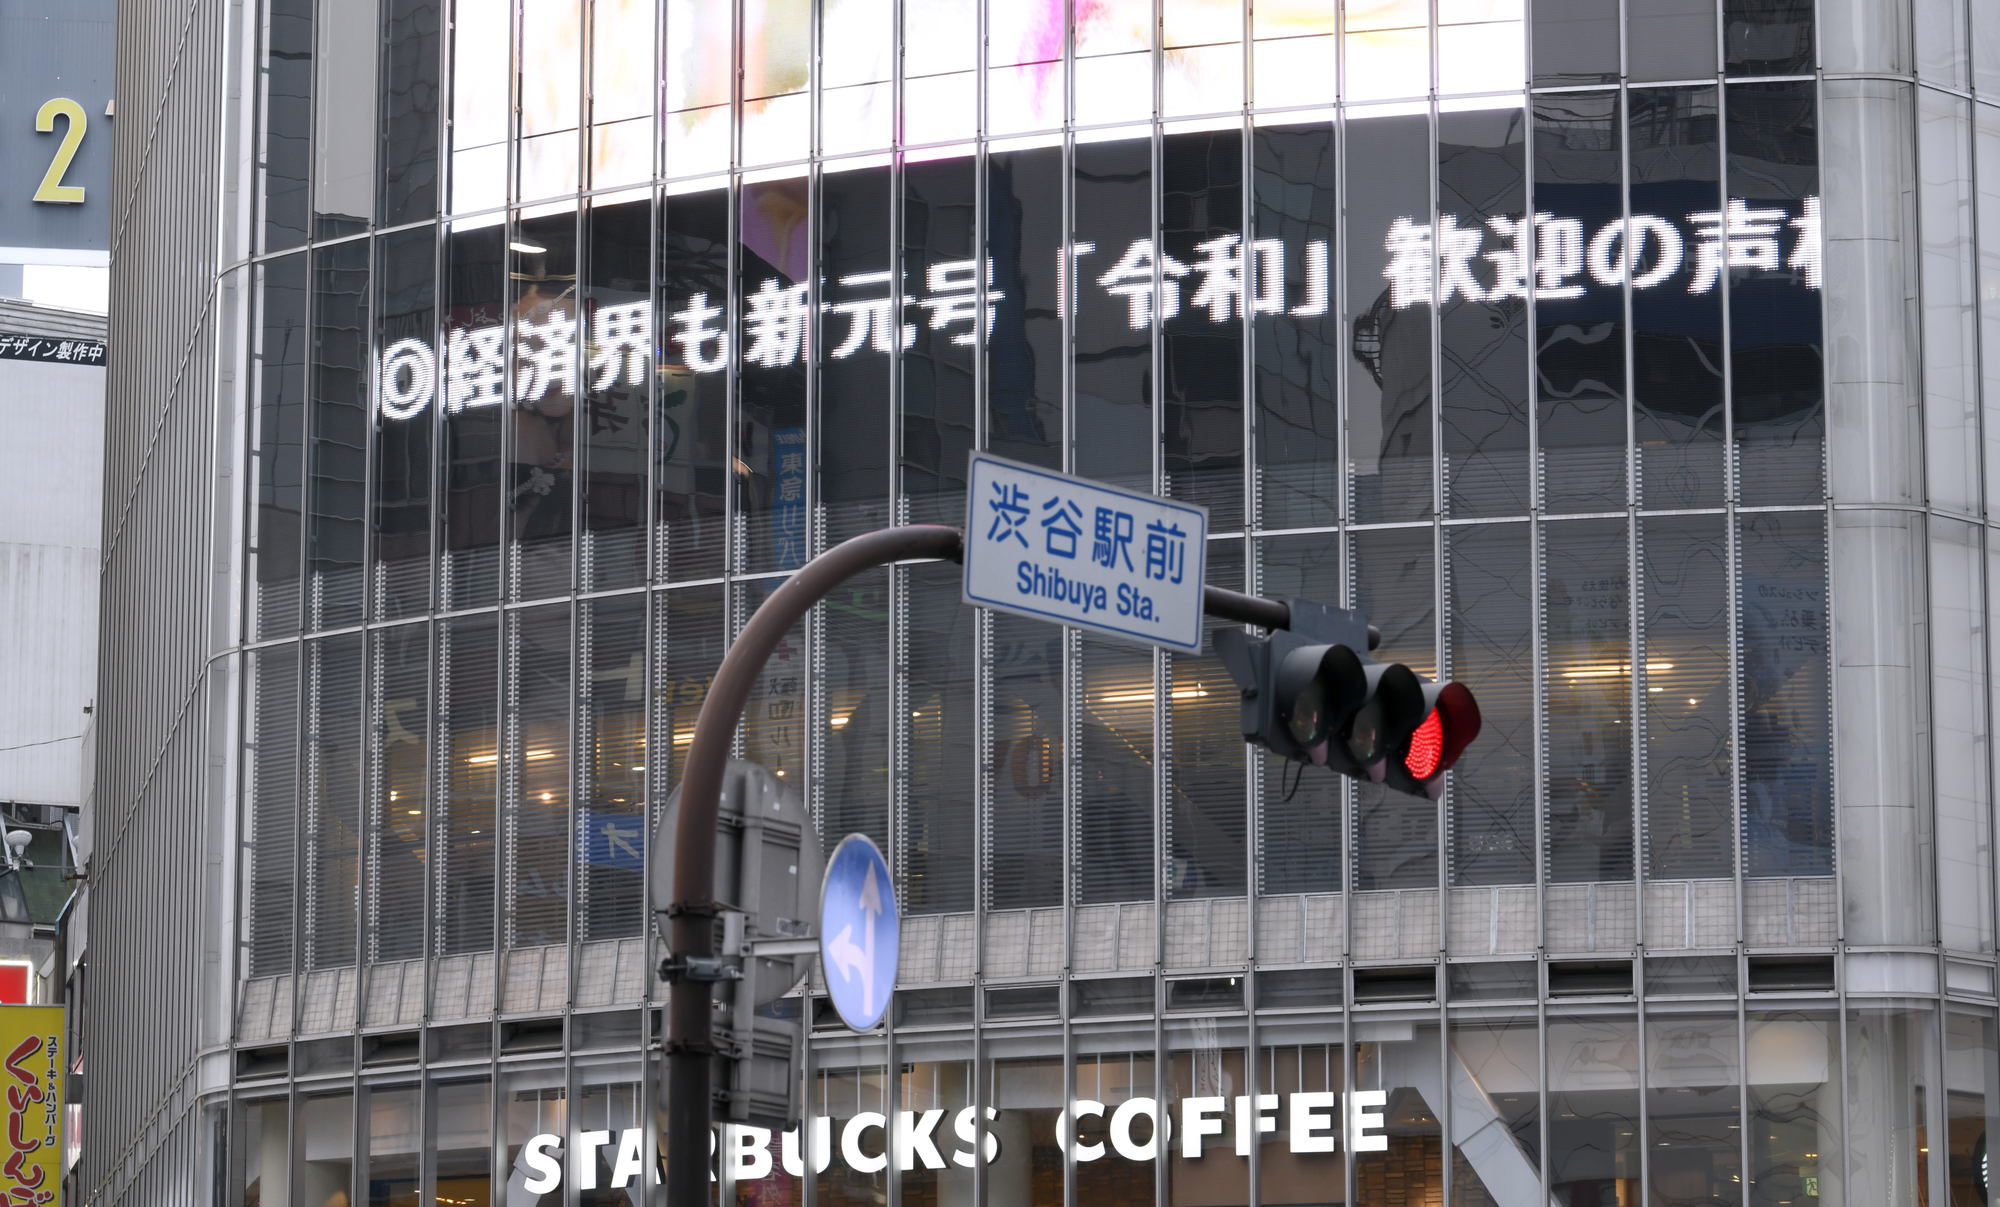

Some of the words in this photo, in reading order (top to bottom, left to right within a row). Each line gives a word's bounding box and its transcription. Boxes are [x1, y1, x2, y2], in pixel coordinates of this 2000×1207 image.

[0, 337, 103, 362] デザイン製作中
[988, 481, 1186, 584] 渋谷駅前
[1017, 561, 1107, 613] Shibuya
[1116, 583, 1160, 623] Sta.
[44, 1035, 58, 1147] ステーキ&ハンバーグ
[1055, 1090, 1388, 1163] COFFEE
